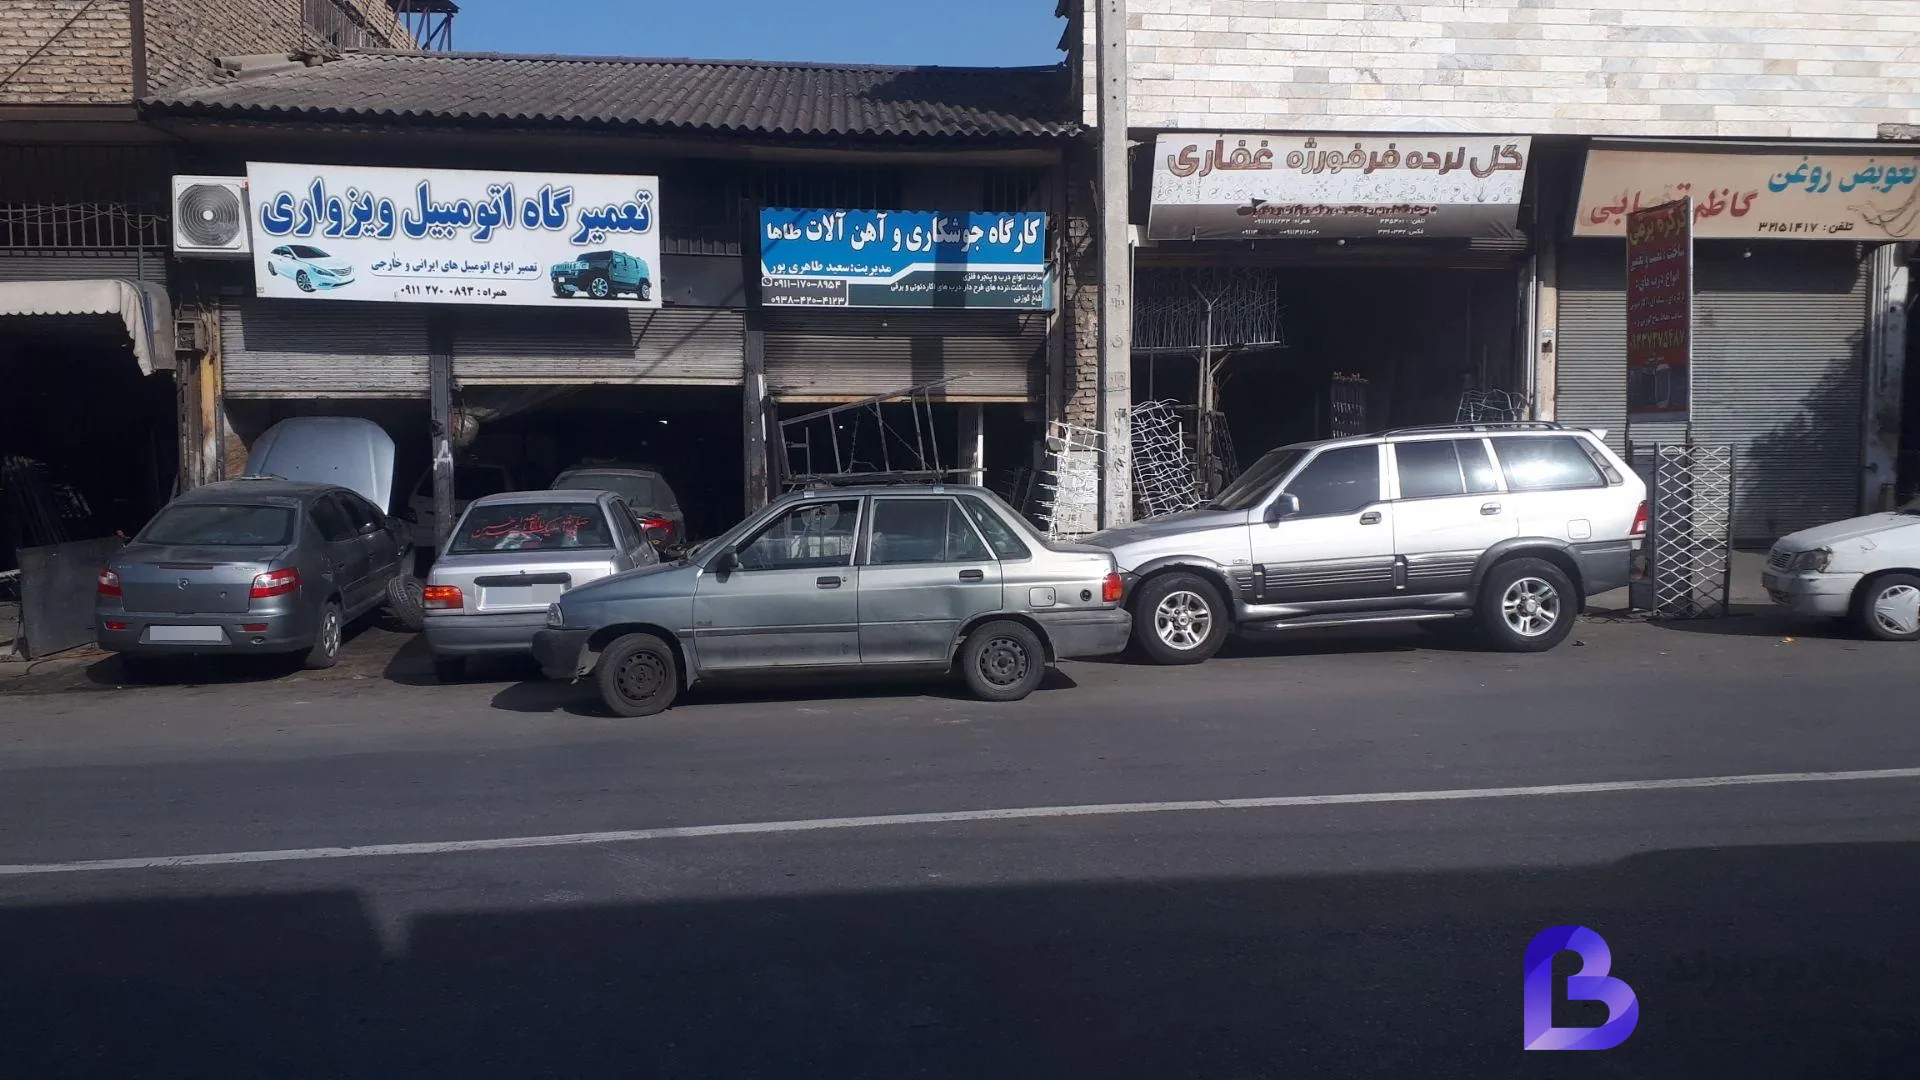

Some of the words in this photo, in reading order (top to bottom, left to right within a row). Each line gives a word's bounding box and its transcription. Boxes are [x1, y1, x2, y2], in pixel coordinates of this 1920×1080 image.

[1167, 139, 1274, 177] غفاری
[1286, 137, 1400, 175] فرفورژه
[1469, 144, 1523, 178] گل
[1768, 155, 1832, 194] روغن
[261, 176, 397, 239] ویزواری
[402, 180, 513, 241] اتومبیل
[520, 184, 572, 230] گاه
[570, 188, 652, 245] تعمیر
[766, 220, 802, 241] طاها
[806, 212, 847, 241] آلات
[850, 212, 888, 250] آهن
[891, 225, 901, 252] و
[906, 216, 985, 253] جوشکاری
[988, 216, 1041, 253] کارگاه
[371, 258, 402, 271] خارجی
[405, 262, 410, 272] و
[412, 259, 438, 273] ایرانی
[440, 259, 458, 273] های
[461, 260, 490, 274] اتومبیل
[492, 261, 514, 274] انواع
[516, 262, 538, 275] تعمیر
[770, 263, 786, 275] پور
[788, 261, 823, 275] طاهری
[400, 284, 421, 296] ۰۹۱۱
[425, 285, 444, 296] ۲۷۰
[449, 285, 474, 297] ۰۸۹۳
